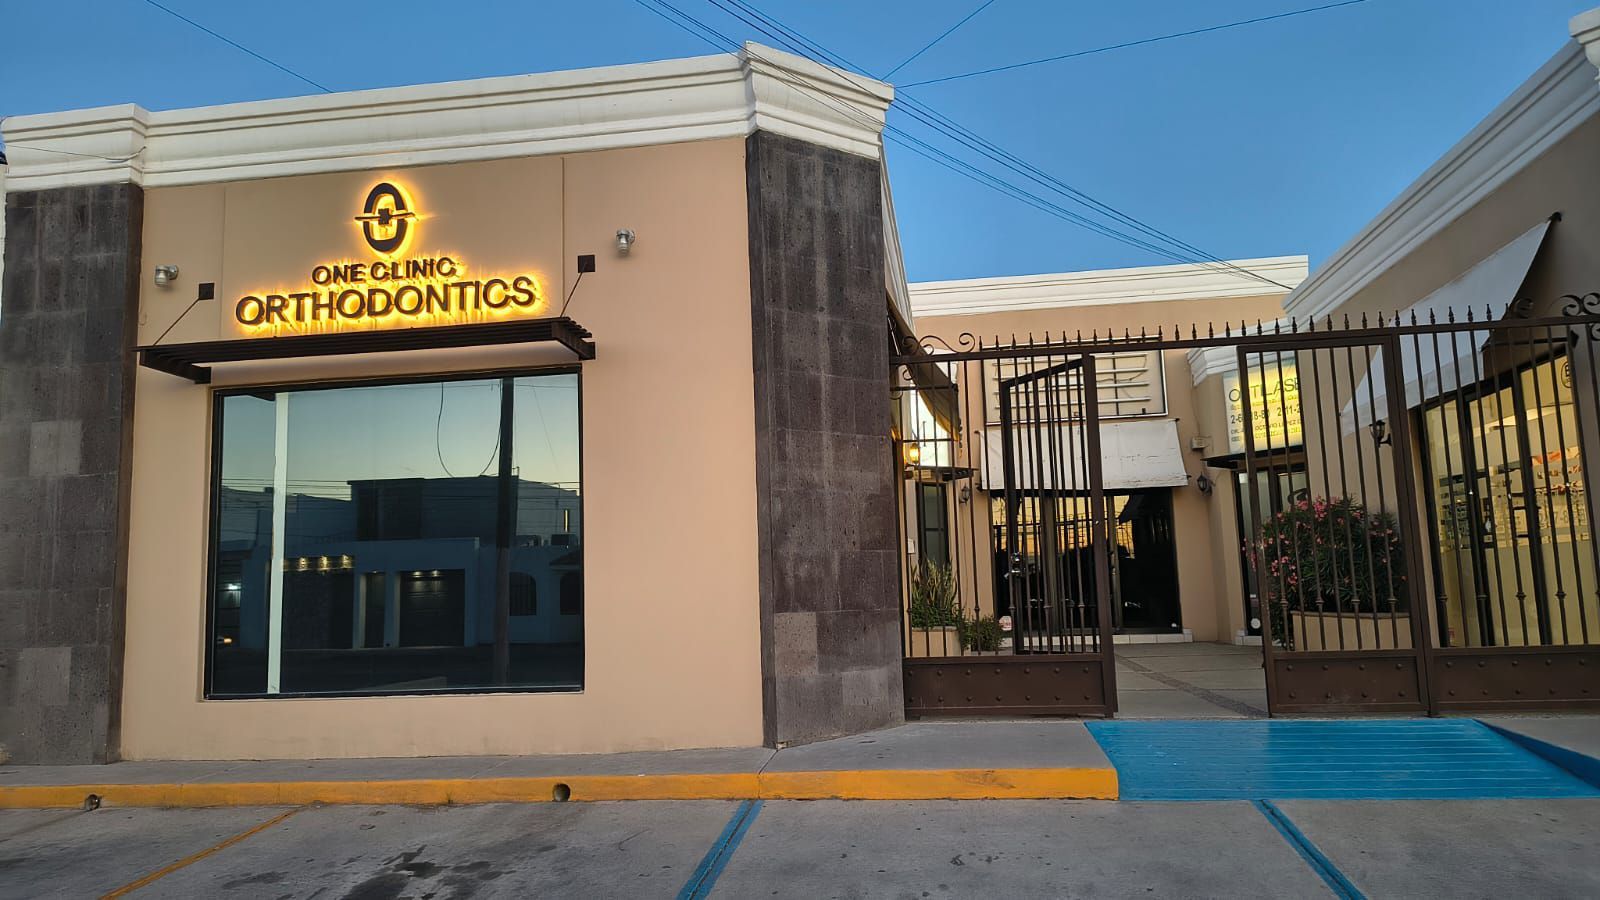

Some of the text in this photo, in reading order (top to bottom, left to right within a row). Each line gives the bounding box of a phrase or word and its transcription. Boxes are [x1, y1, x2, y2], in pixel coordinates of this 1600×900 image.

[312, 256, 457, 285] ONE CLINIC
[235, 276, 536, 326] ORTHODONTICS
